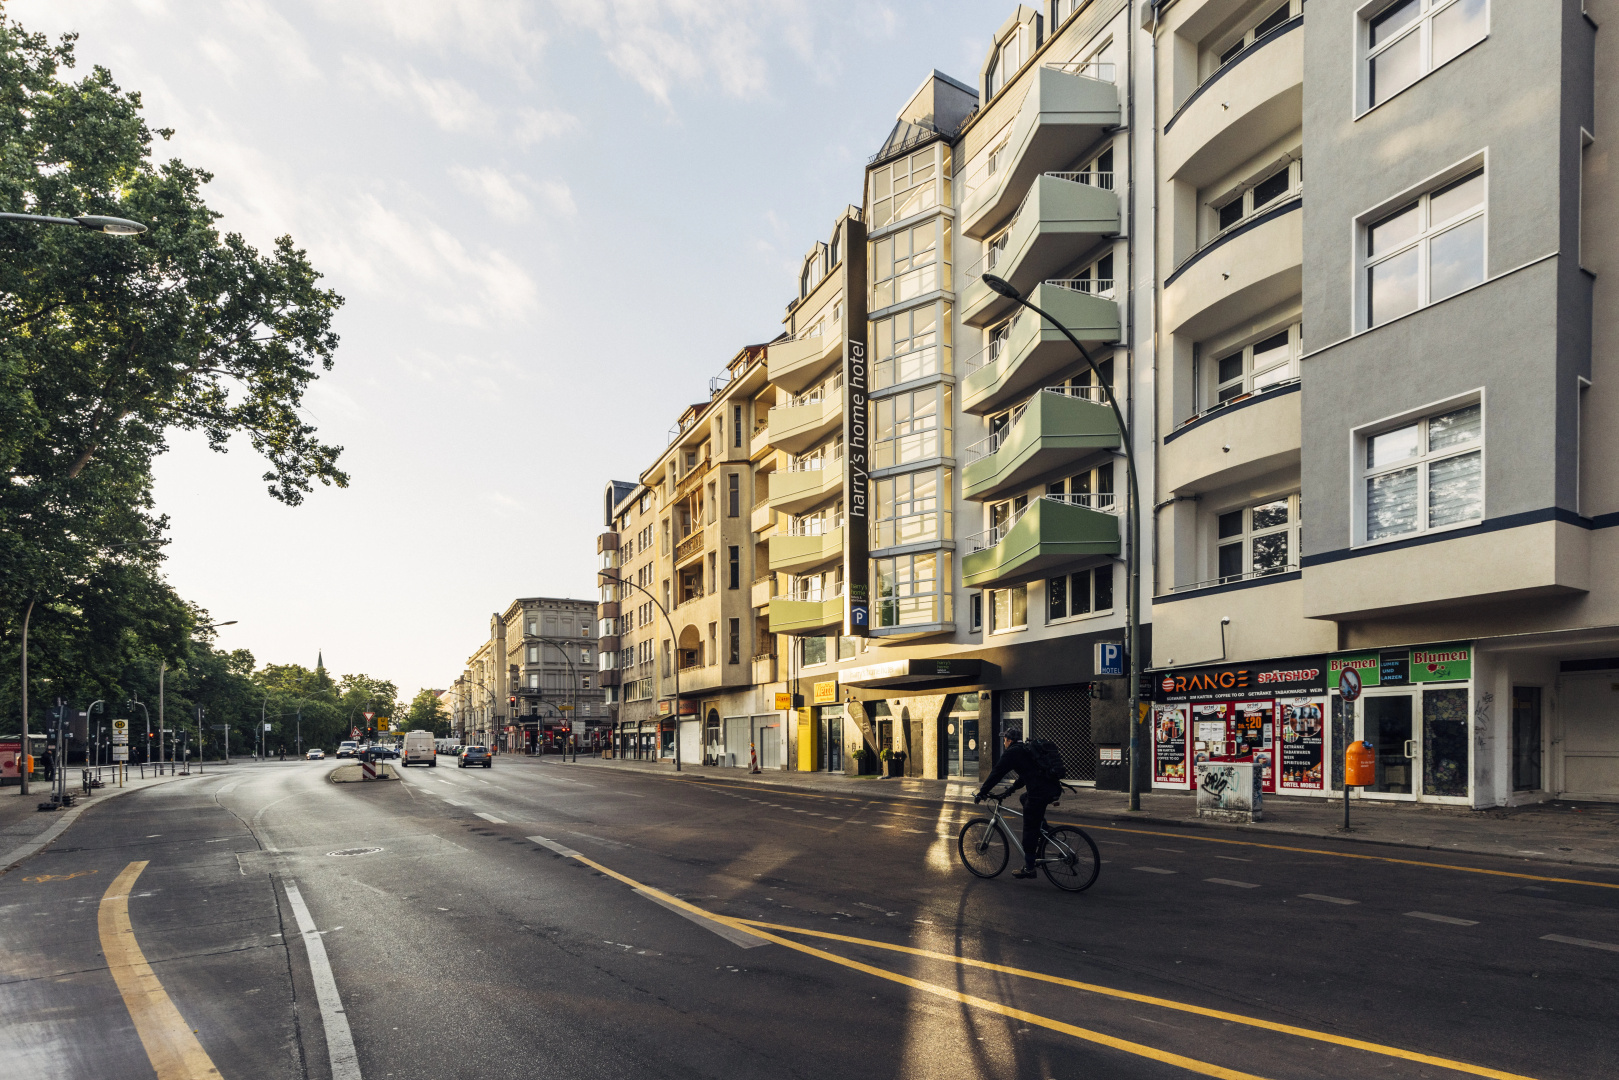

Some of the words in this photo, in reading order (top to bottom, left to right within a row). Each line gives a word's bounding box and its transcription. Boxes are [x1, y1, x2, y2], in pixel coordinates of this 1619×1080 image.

[849, 339, 864, 389] hotel
[849, 393, 865, 448] home
[849, 453, 868, 517] harry's
[856, 612, 863, 624] P
[1105, 645, 1118, 666] P
[1413, 651, 1468, 664] Blumen
[1330, 658, 1377, 671] Blumen
[1257, 668, 1320, 684] SPÄTSHOP
[816, 683, 834, 698] Netto
